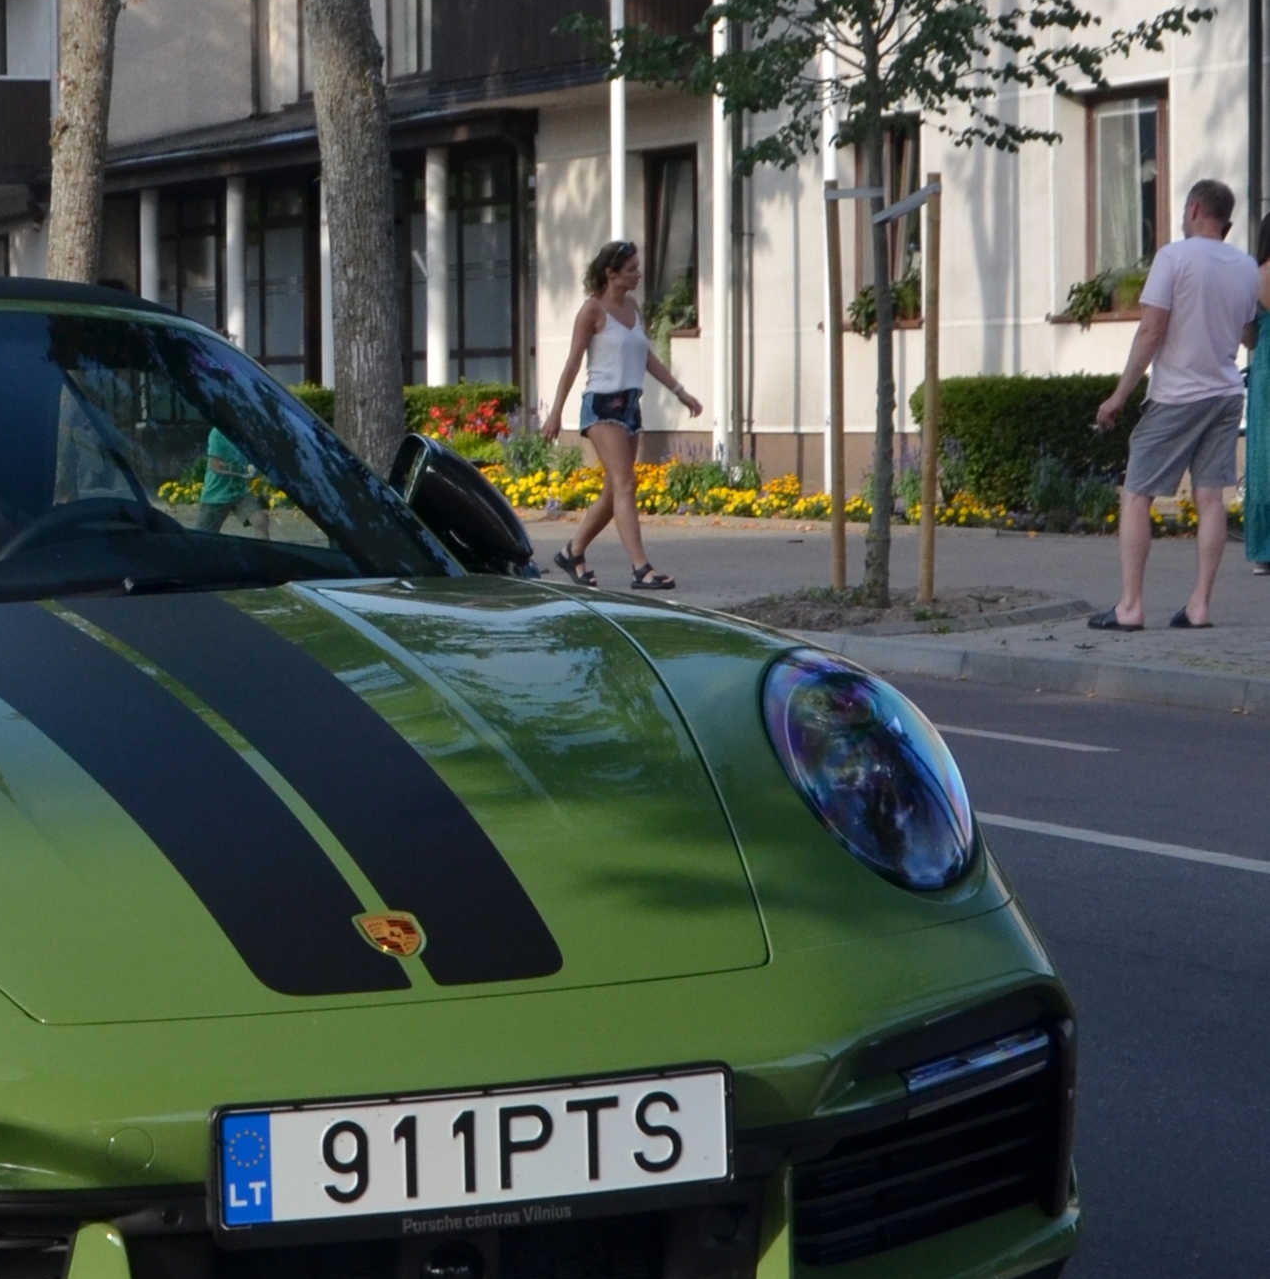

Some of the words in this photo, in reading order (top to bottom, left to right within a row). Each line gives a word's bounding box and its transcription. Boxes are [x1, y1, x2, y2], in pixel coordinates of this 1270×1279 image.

[321, 1090, 684, 1204] 911PTS
[229, 1180, 267, 1207] LT
[401, 1214, 463, 1234] Porsche
[523, 1203, 572, 1223] Vilnius
